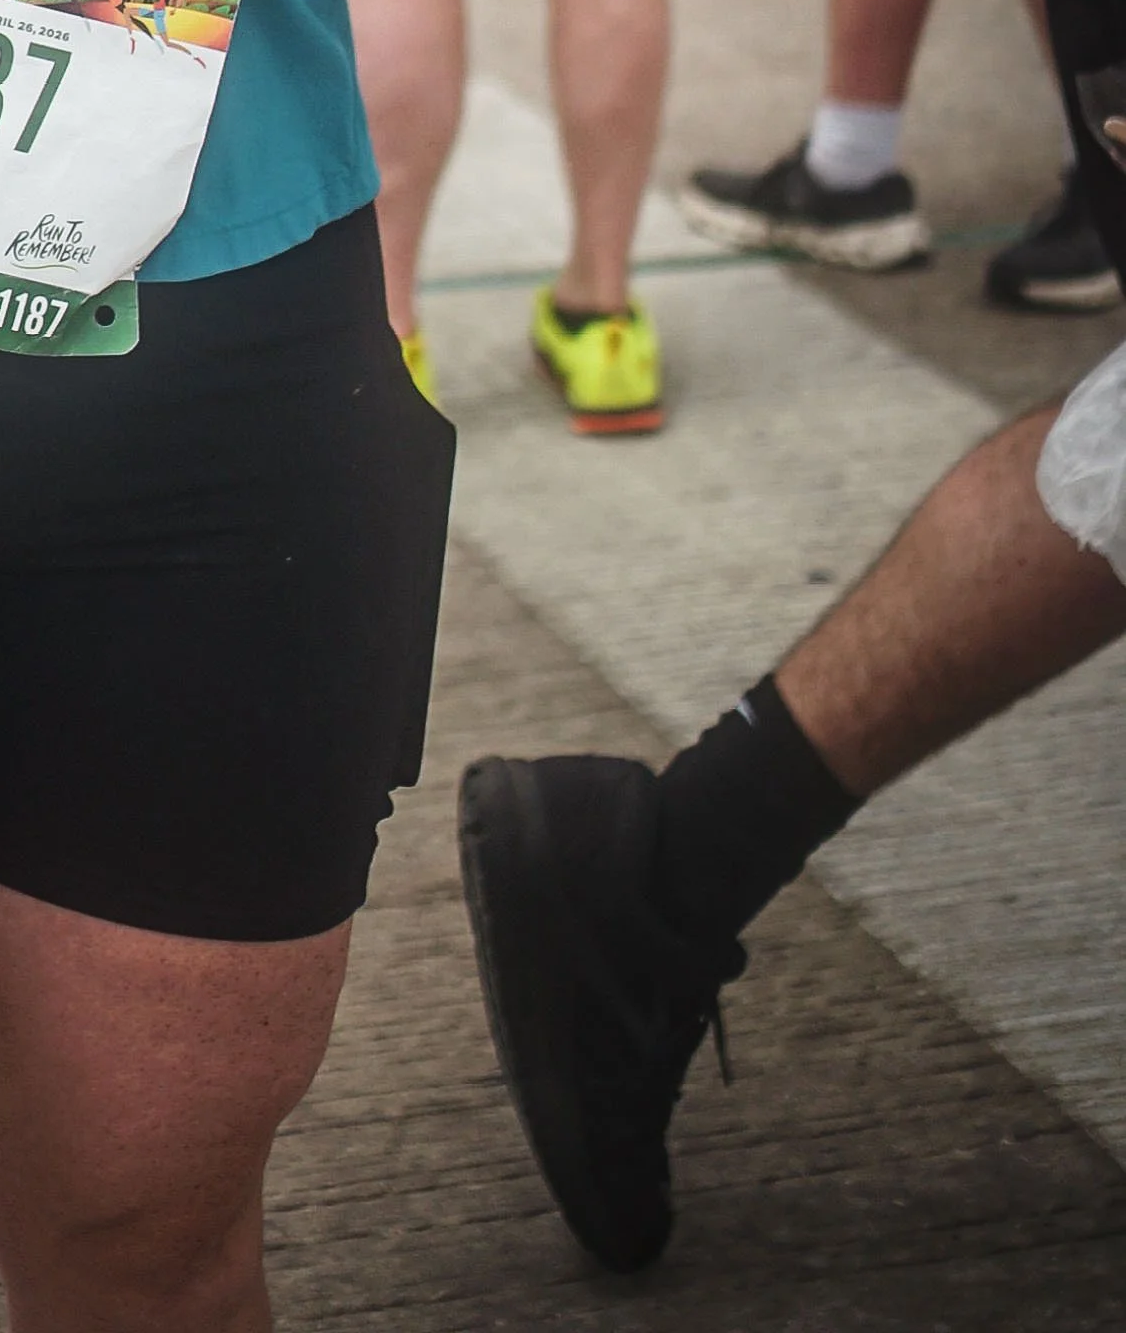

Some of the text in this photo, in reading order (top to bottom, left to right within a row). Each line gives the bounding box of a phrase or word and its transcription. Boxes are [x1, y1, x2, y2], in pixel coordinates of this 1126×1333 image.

[18, 21, 36, 35] 26,
[38, 26, 70, 42] 2026
[4, 230, 96, 264] REMEMBER!
